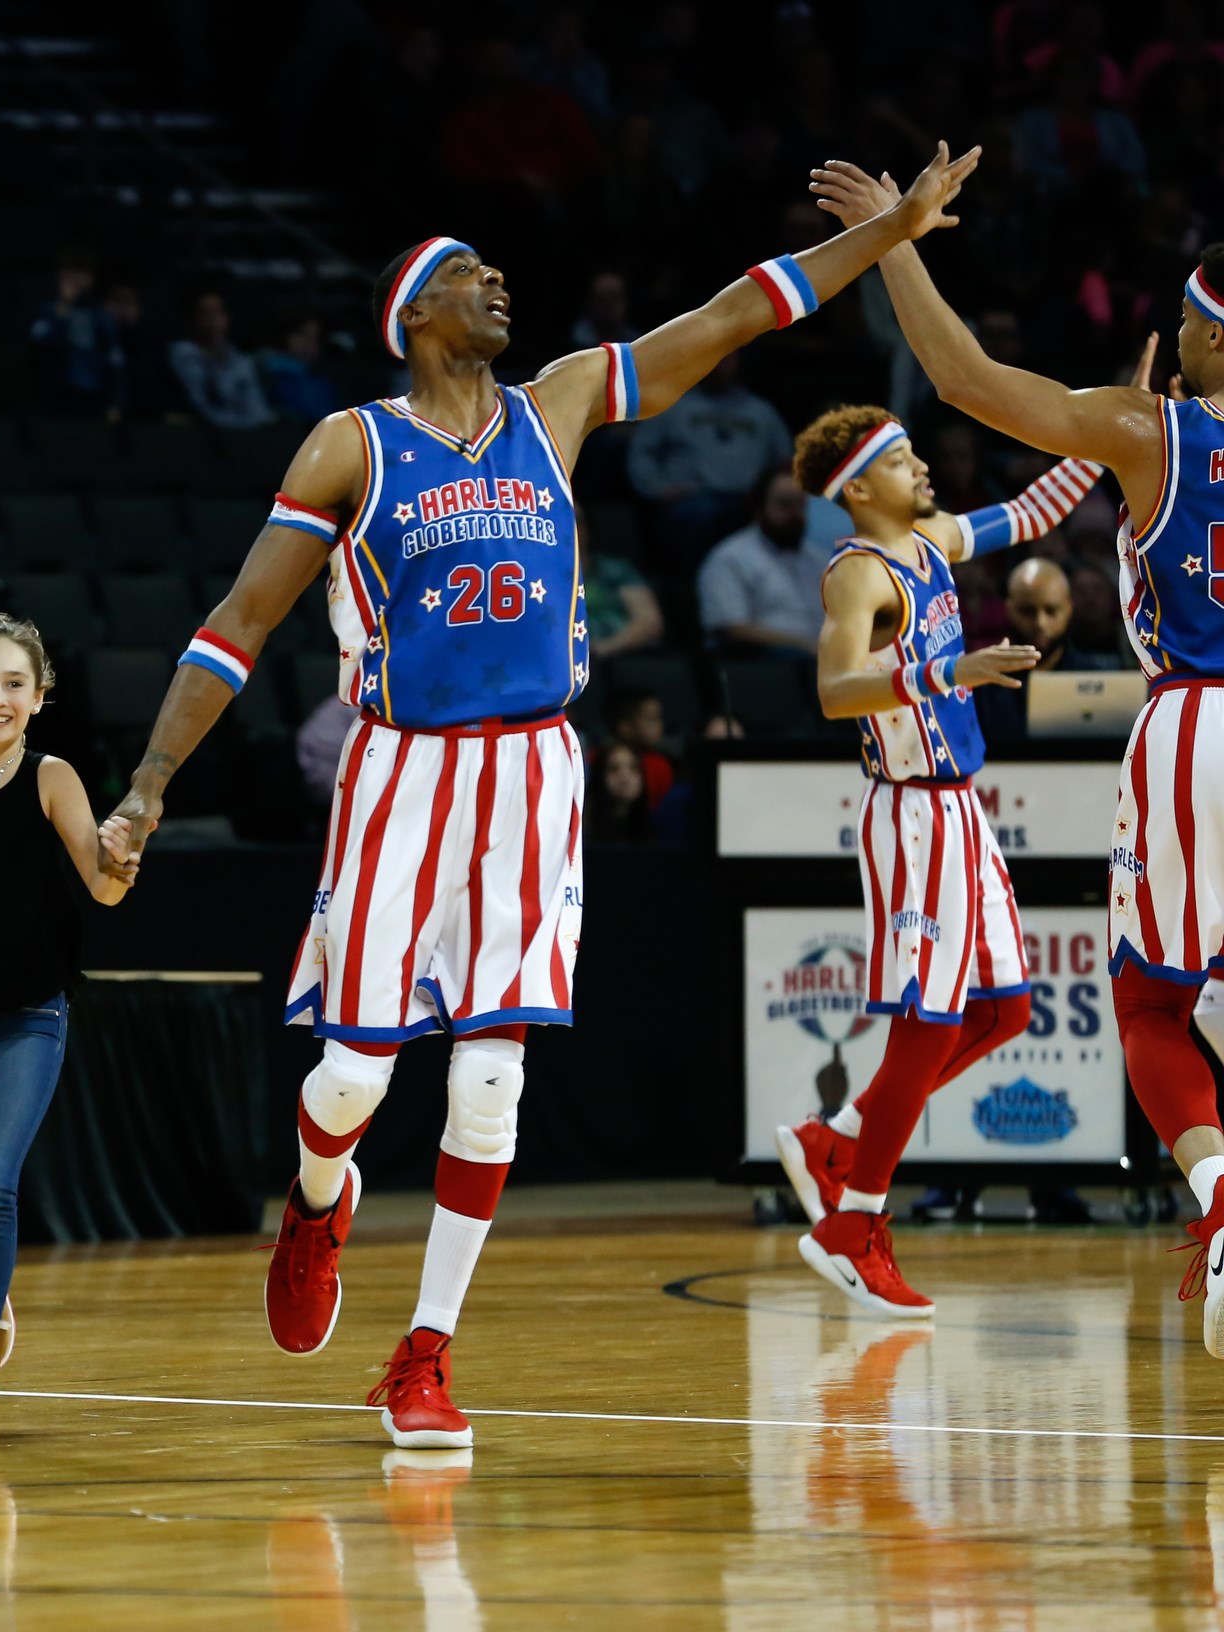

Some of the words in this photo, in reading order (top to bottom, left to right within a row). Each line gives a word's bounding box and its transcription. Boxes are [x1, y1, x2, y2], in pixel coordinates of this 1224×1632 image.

[418, 477, 537, 524] HARLEM
[402, 513, 558, 559] GLOBETROTTERS
[446, 560, 525, 627] 26
[1023, 932, 1096, 976] GIC
[782, 964, 866, 997] HARLE
[1027, 981, 1102, 1040] SS
